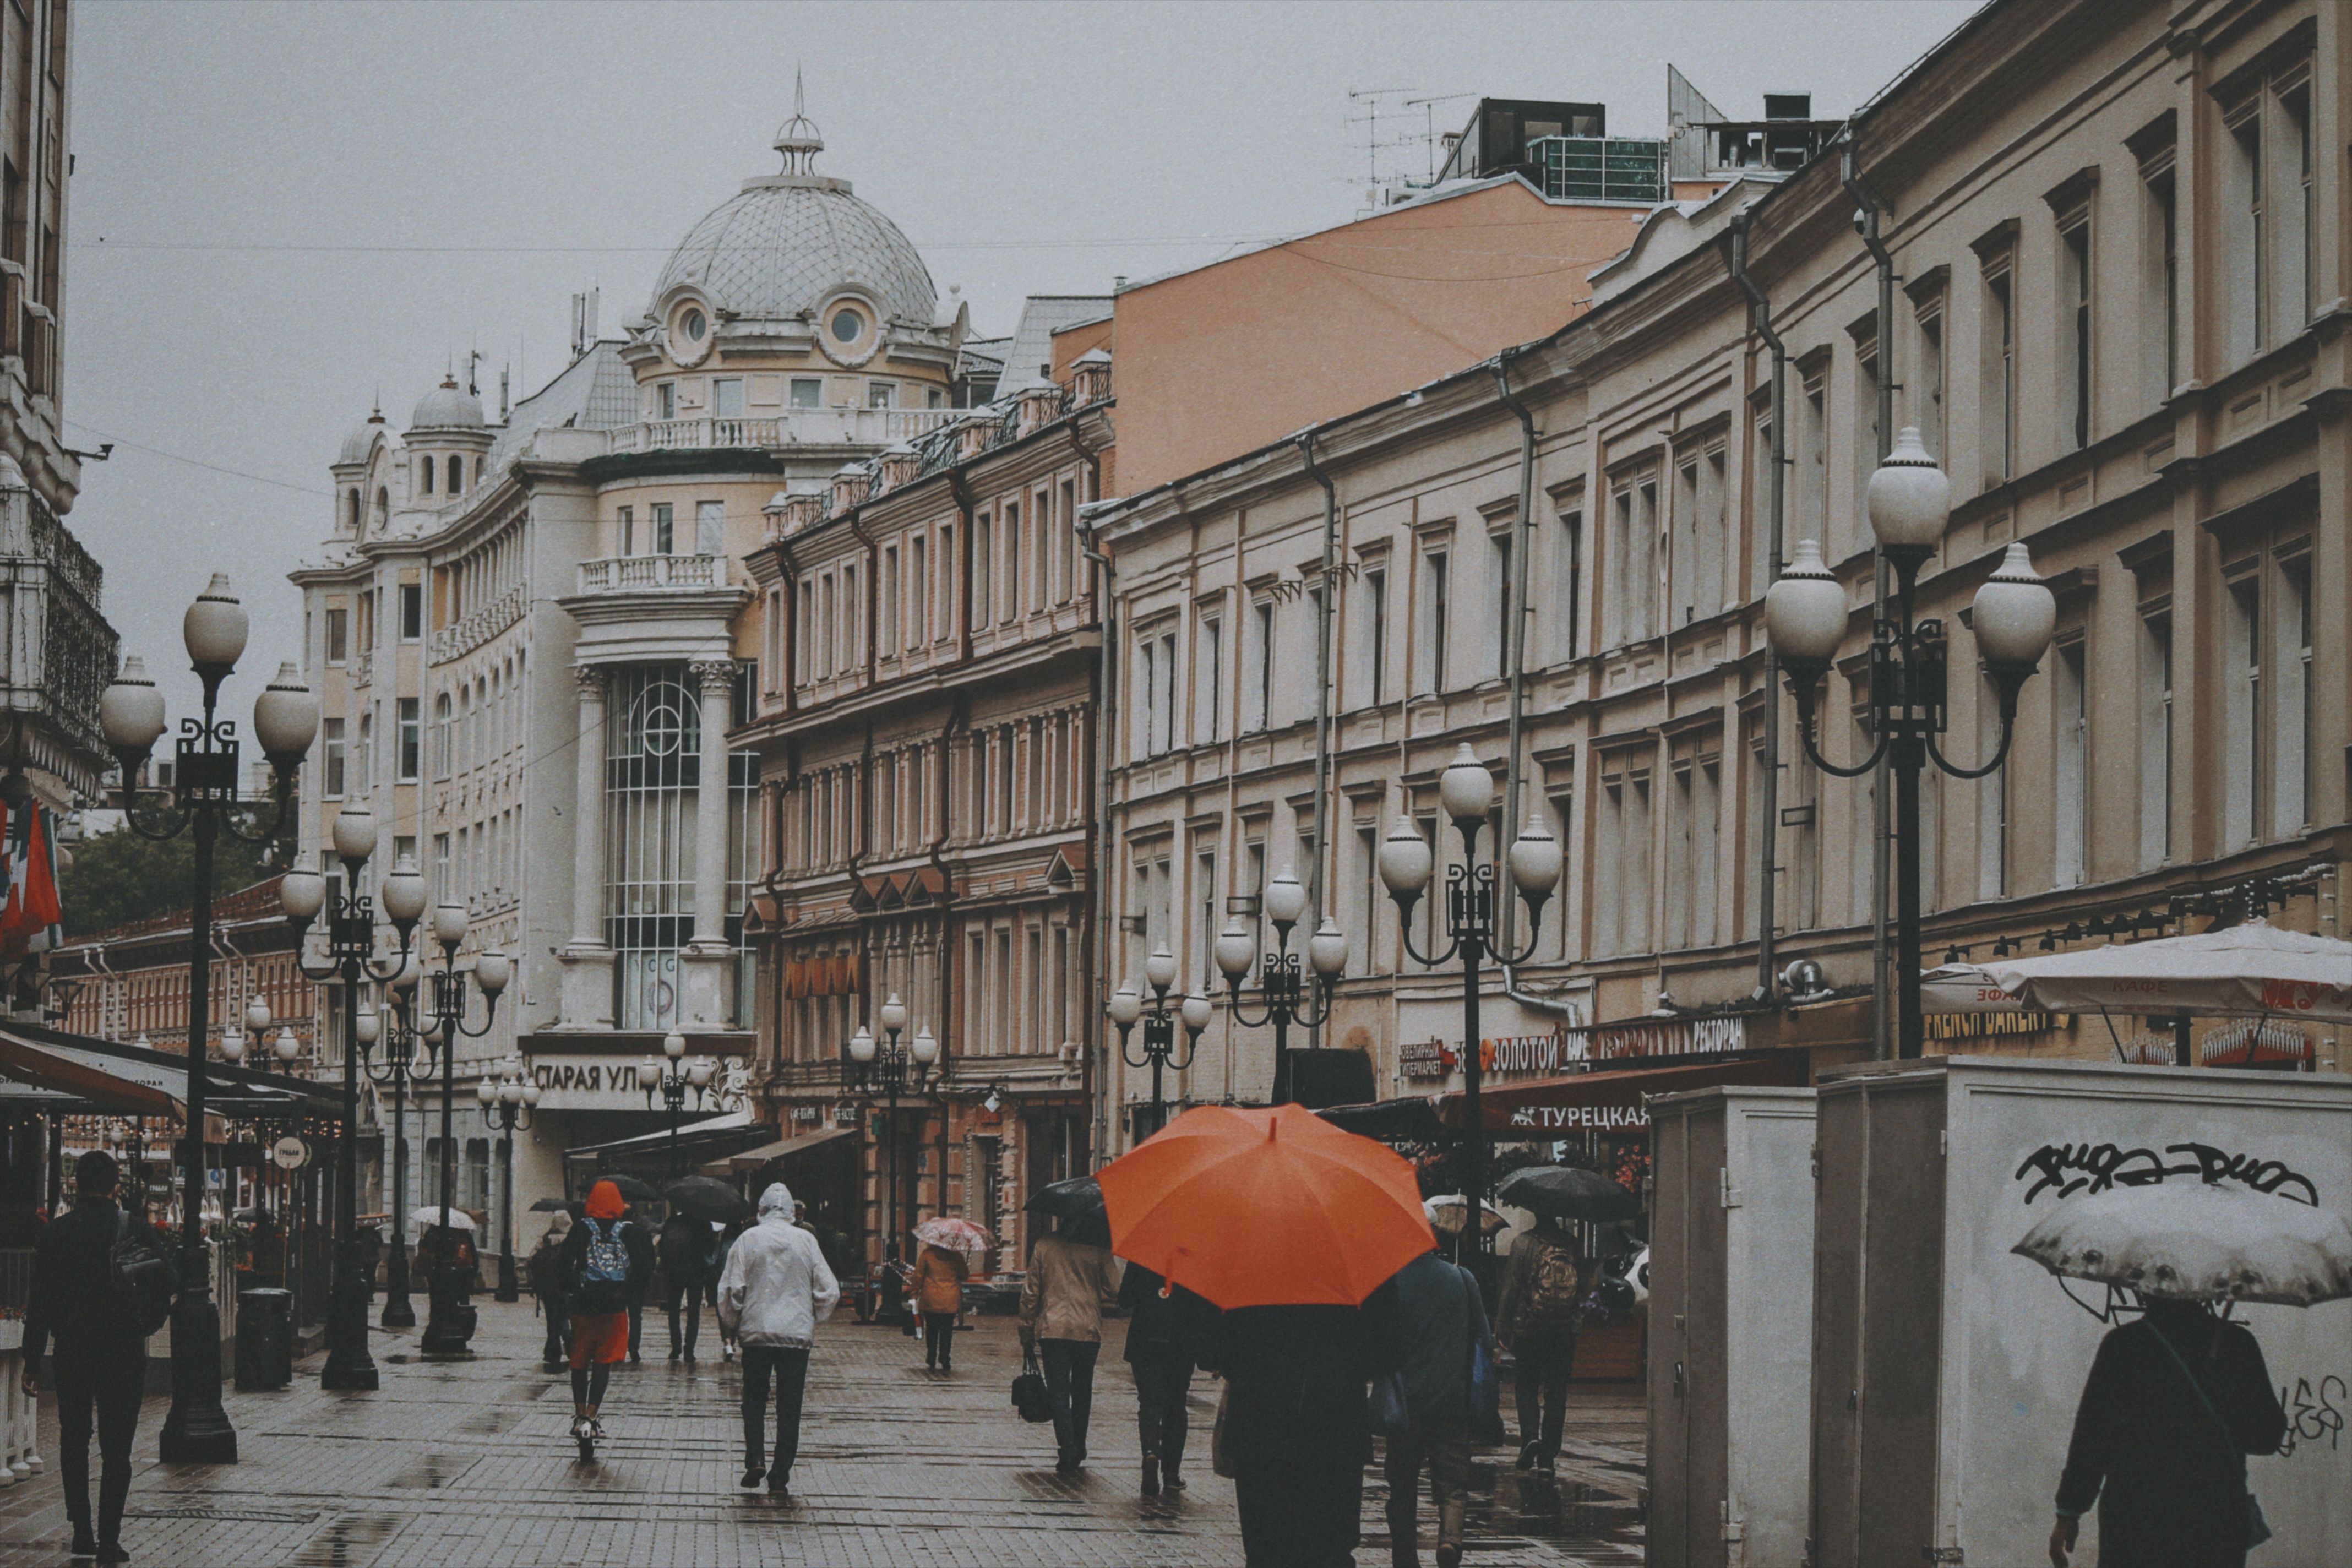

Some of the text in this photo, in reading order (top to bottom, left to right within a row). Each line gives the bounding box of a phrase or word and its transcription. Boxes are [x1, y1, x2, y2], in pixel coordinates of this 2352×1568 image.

[1694, 1017, 1742, 1053] РЕСТОРАН
[535, 1065, 600, 1092] СТАРАЯ
[1539, 1106, 1651, 1131] ТУРЕЦКАЯ
